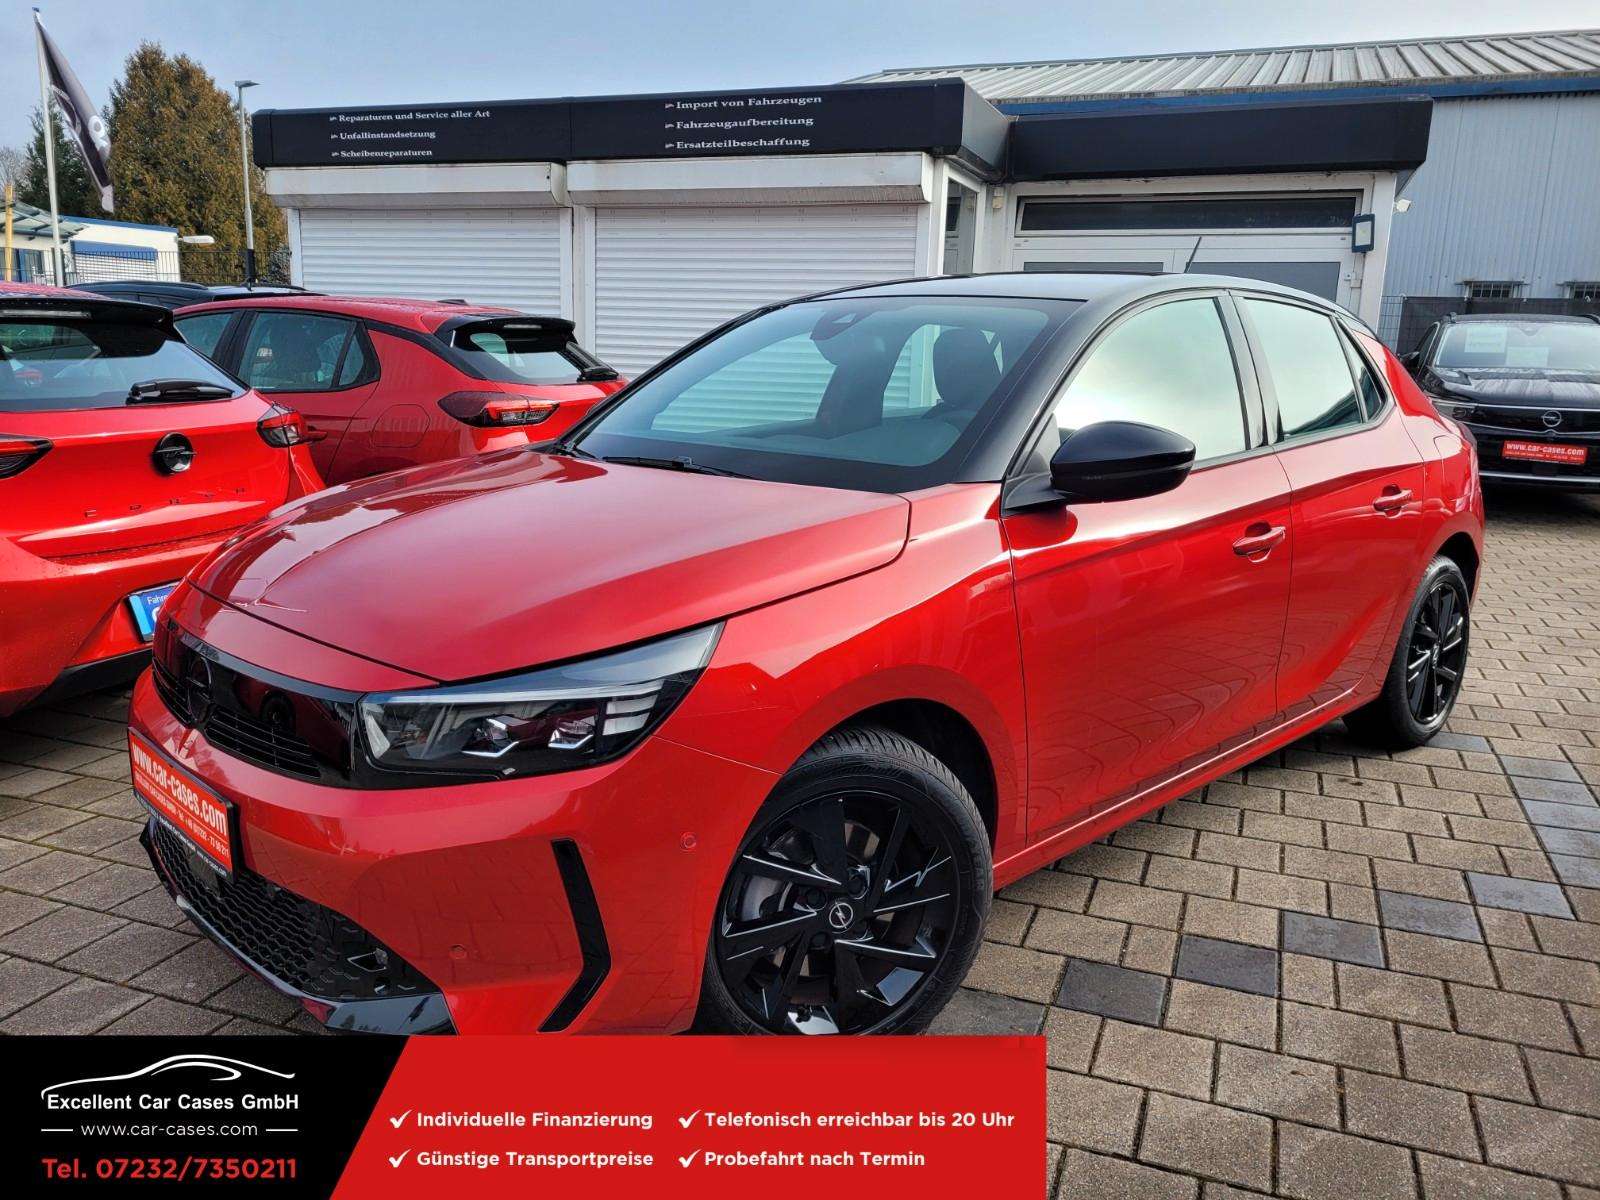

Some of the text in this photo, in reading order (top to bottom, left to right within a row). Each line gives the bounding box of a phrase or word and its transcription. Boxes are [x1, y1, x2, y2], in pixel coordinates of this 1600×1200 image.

[676, 96, 822, 110] Import von Fahrzeugen
[338, 109, 491, 123] Reparaturen und Service aller Art
[676, 117, 814, 130] Fahrzeugaufbereitung
[339, 130, 436, 140] Unfallinstandsetzung
[676, 137, 810, 148] Ersatzteilbeschaffung
[340, 149, 433, 159] Scheibenreparaturen
[1506, 443, 1584, 456] www.car-cases.com
[131, 741, 228, 837] www.car-cases.com
